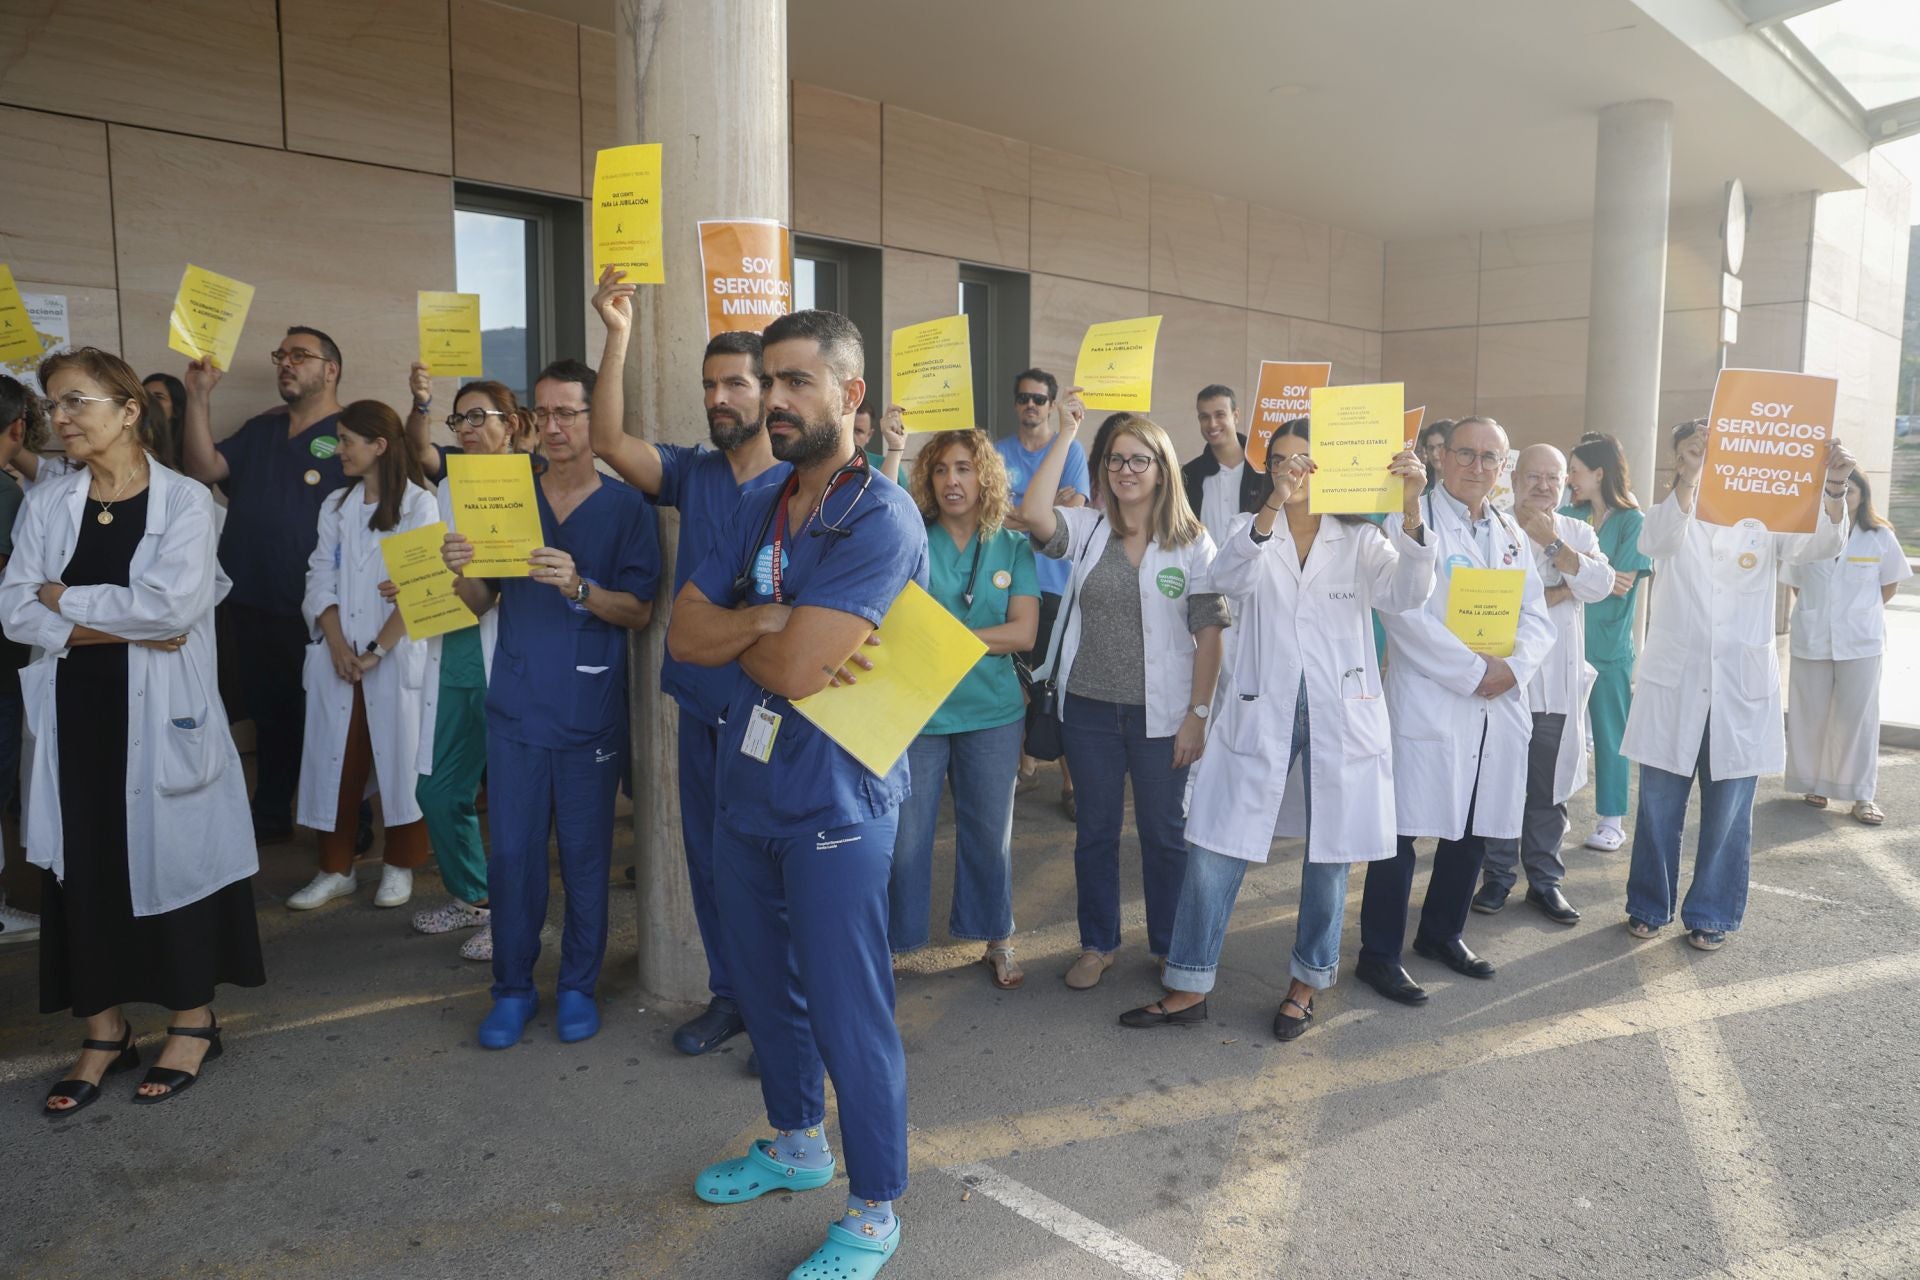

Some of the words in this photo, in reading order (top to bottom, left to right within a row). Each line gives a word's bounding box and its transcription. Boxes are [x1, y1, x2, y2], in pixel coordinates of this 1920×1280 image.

[619, 198, 648, 206] JUBILACIÓN
[742, 256, 774, 274] SOY
[713, 278, 789, 296] SERVICIOS
[722, 295, 787, 316] MÍNIMOS
[1282, 386, 1307, 397] SOY
[1261, 398, 1310, 410] SERVICI
[1750, 402, 1794, 418] SOY
[1716, 418, 1826, 440] SERVICIOS
[1720, 434, 1815, 458] MÍNIMOS
[1714, 464, 1735, 476] YO
[1737, 466, 1792, 480] APOYO
[1794, 472, 1812, 483] LA
[1724, 477, 1800, 496] HUELGA
